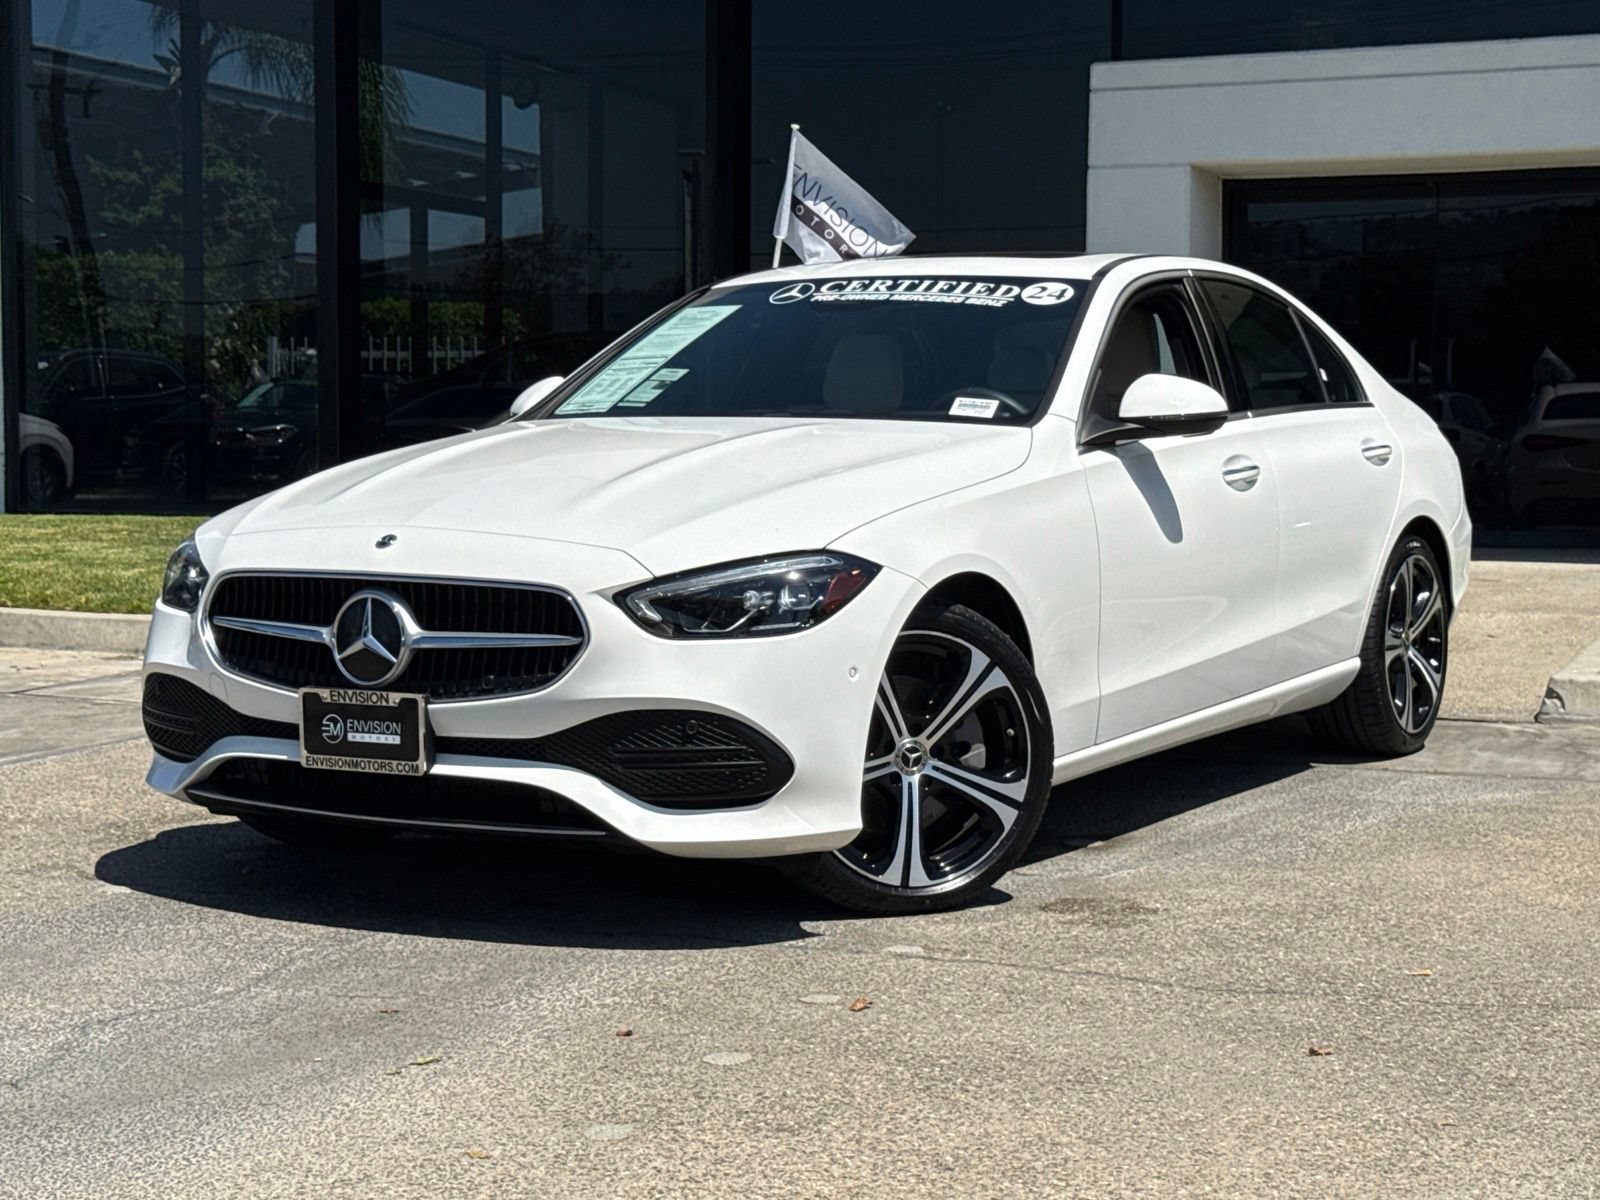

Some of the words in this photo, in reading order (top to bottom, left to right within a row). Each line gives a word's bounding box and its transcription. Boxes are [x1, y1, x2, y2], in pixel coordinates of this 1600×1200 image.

[820, 280, 1021, 298] CERTIFIED
[1027, 286, 1070, 301] 24
[810, 294, 890, 302] PRE-OWNED
[889, 294, 965, 303] MERCEDES
[964, 298, 1008, 307] BENZ
[329, 690, 390, 705] ENVISION
[346, 719, 401, 735] ENVISION
[305, 755, 420, 774] ENVISIONMOTORS.COM
